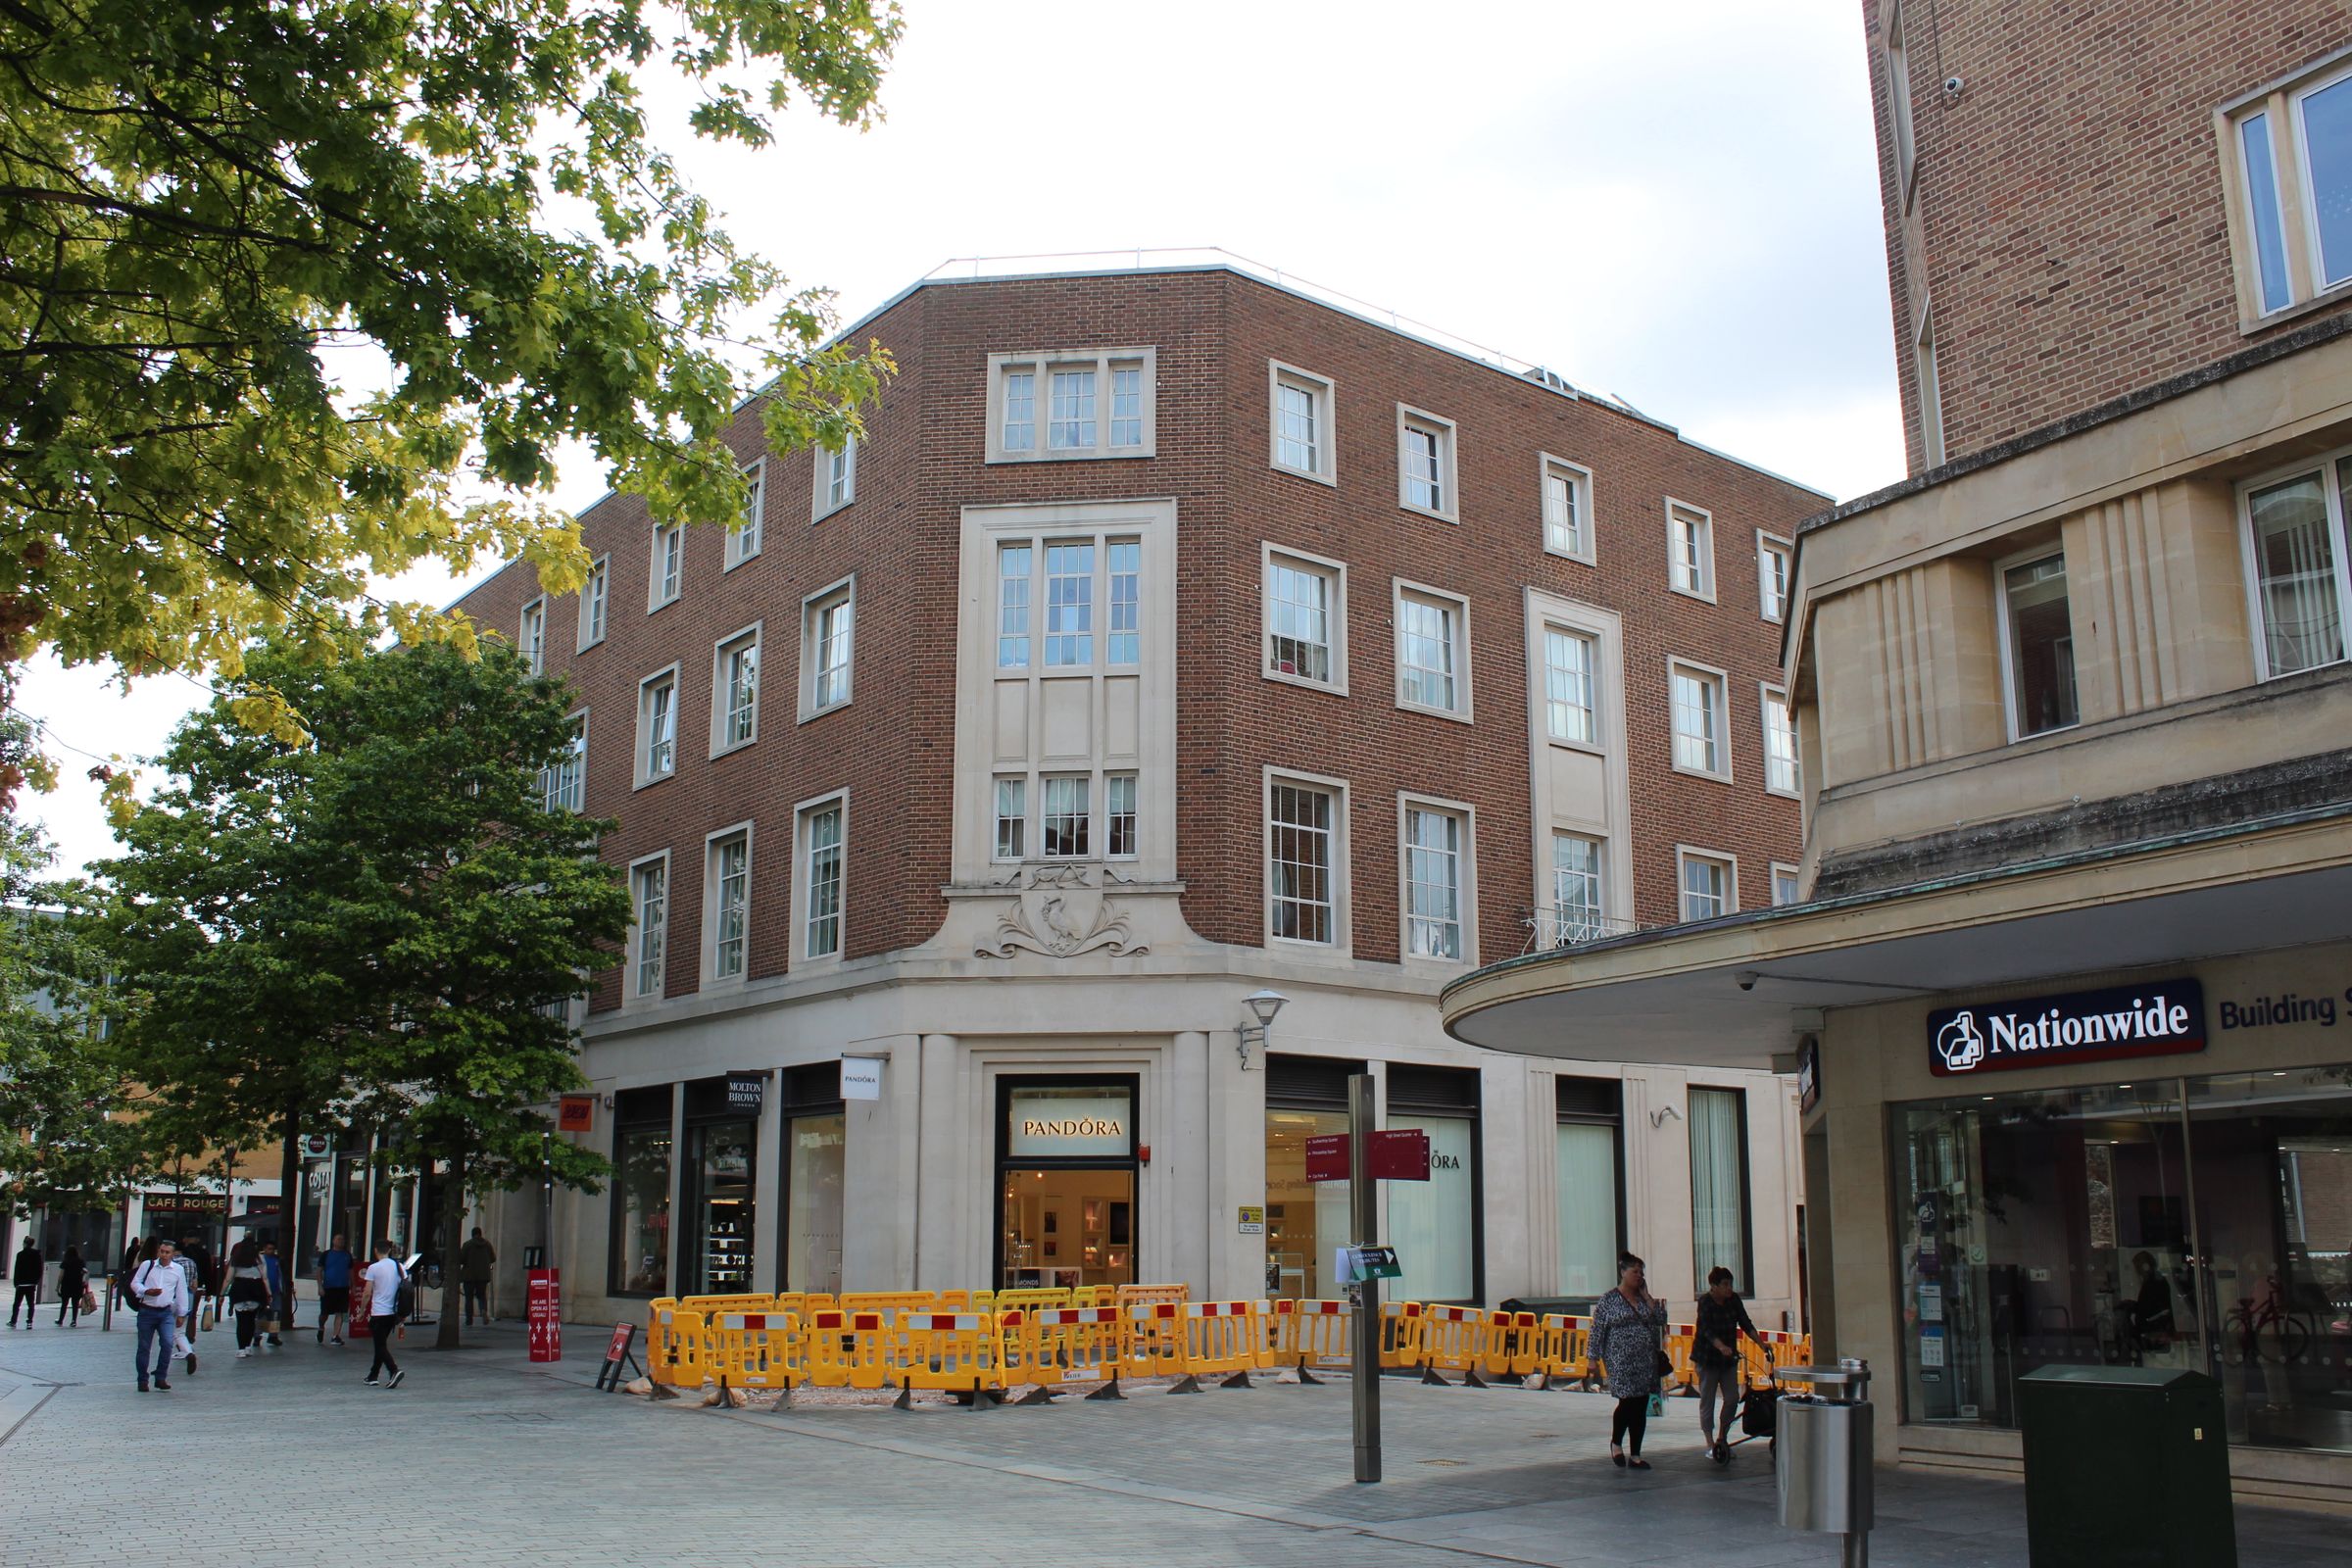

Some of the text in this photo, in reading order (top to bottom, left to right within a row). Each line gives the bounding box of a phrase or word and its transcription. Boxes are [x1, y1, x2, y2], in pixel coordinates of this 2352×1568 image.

[2220, 994, 2336, 1030] Building
[1988, 996, 2189, 1054] Nationwide
[729, 1082, 760, 1092] MOLTON
[728, 1092, 760, 1102] BROWN
[1024, 1119, 1121, 1135] PANDORA
[309, 1172, 330, 1188] COSTA
[183, 1199, 225, 1207] ROUGE
